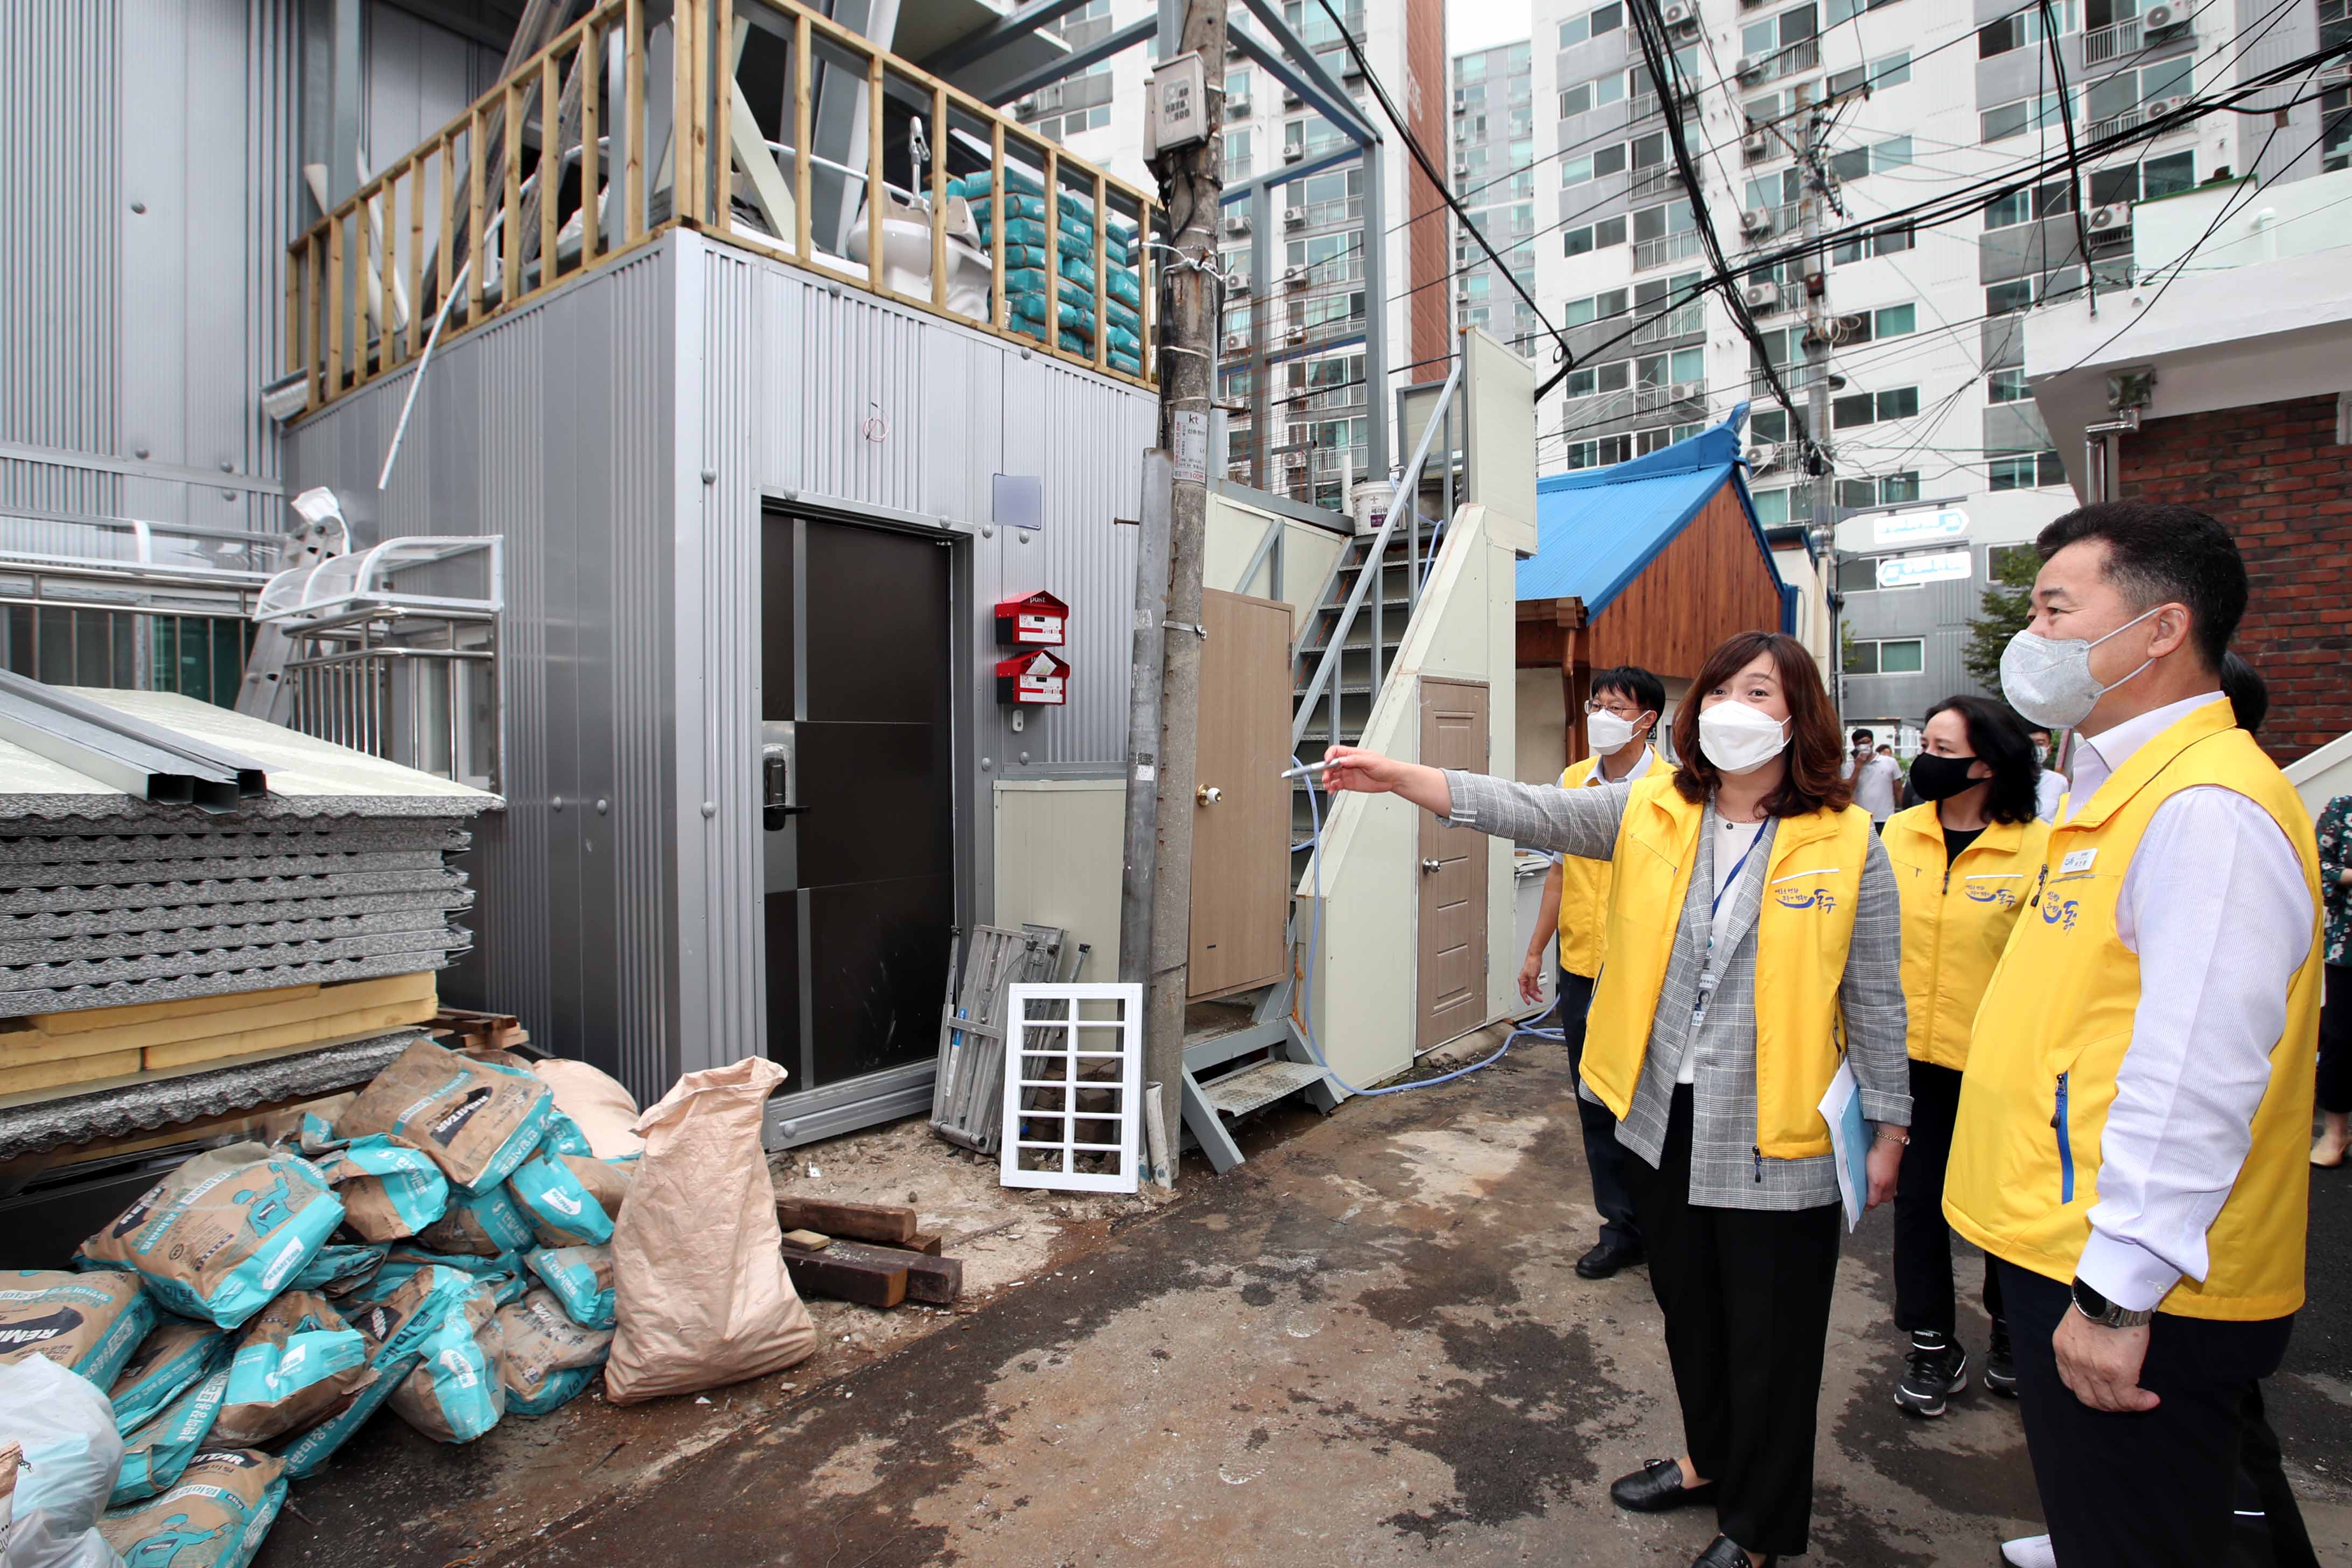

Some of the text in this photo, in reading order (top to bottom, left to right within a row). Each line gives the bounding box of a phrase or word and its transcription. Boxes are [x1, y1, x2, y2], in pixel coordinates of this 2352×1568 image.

[1189, 414, 1199, 424] kt
[1814, 888, 1837, 914] 동구
[434, 1095, 489, 1133] REMITAR
[380, 1310, 432, 1363] 레미탈
[177, 1402, 212, 1442] 일반미장용
